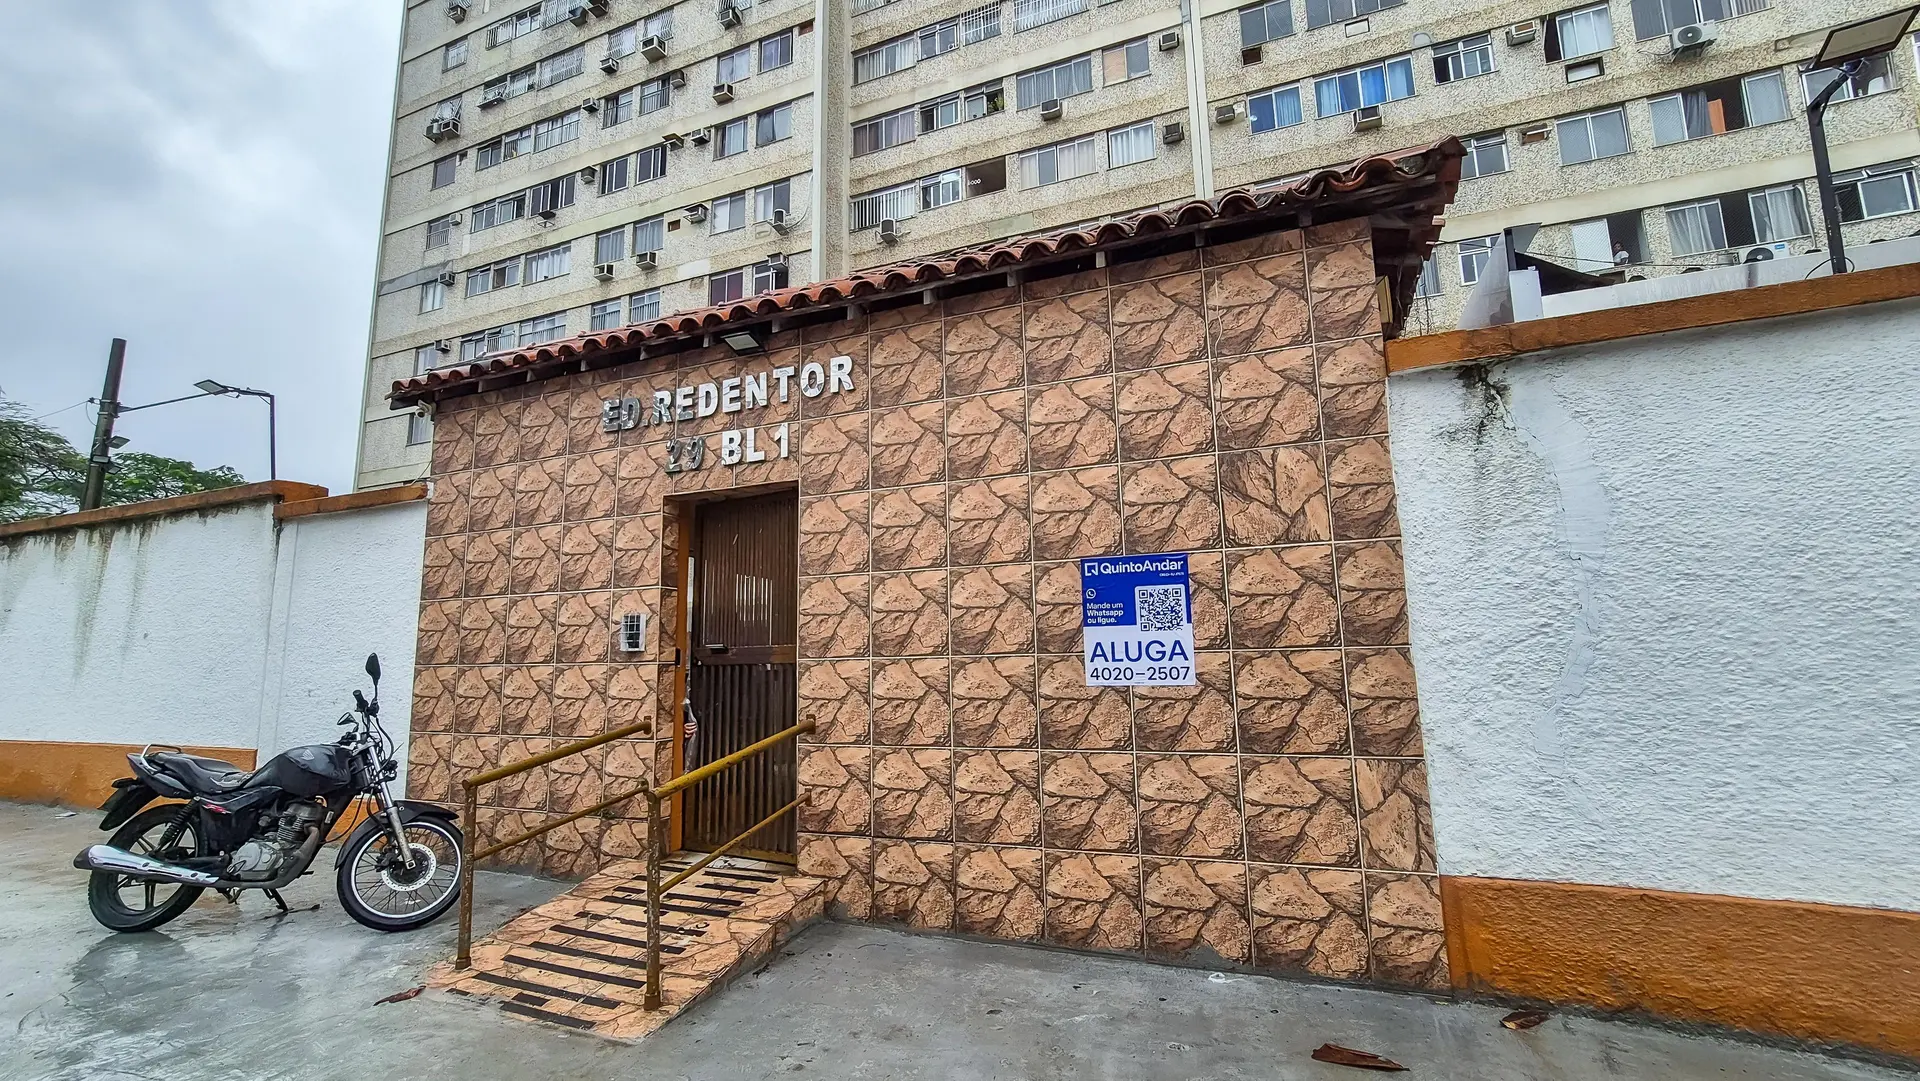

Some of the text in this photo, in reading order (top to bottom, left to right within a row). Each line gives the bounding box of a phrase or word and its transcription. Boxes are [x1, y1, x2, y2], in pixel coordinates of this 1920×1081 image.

[653, 355, 855, 425] REDENTOR
[665, 436, 705, 473] 29
[1100, 559, 1184, 574] QuintoAndar
[1086, 602, 1110, 610] Mande
[1097, 617, 1117, 625] ligue.
[1090, 640, 1189, 662] ALUGA
[1090, 666, 1190, 680] 4020-2507
